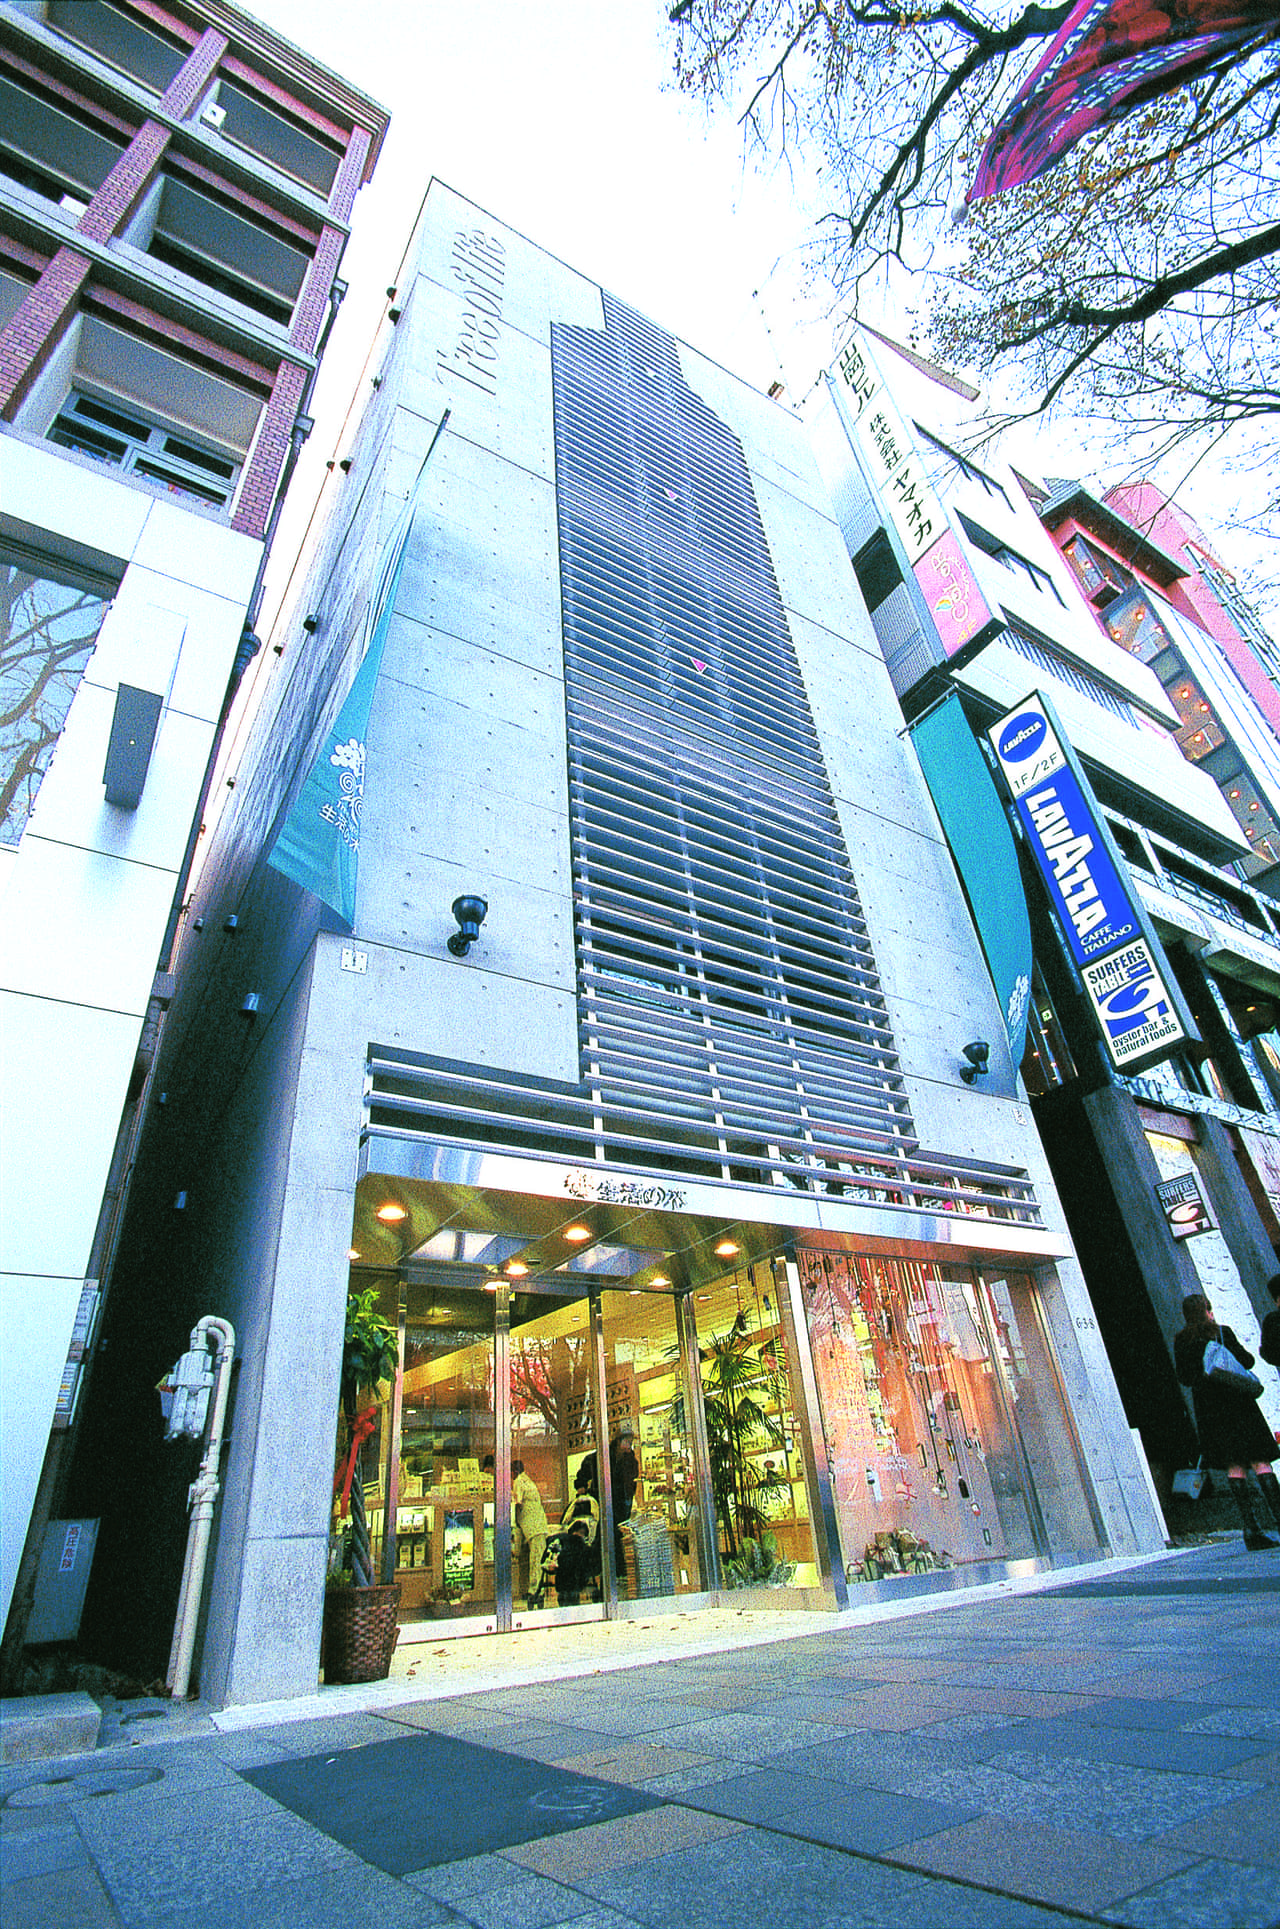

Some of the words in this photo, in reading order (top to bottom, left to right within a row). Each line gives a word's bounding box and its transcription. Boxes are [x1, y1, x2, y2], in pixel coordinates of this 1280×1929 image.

[839, 343, 875, 413] 山岡ビル
[869, 413, 903, 470] 株式会社
[892, 468, 932, 546] ヤマオカ
[1013, 752, 1058, 789] 1F/2F
[1025, 786, 1108, 938] LAVAZZA
[1083, 924, 1132, 956] ITALIANO
[1088, 946, 1146, 985] SURFERS
[1092, 969, 1131, 998] TABLE
[1112, 1027, 1141, 1049] oyster
[1141, 1020, 1159, 1038] bar
[1161, 1016, 1170, 1026] &
[1115, 1031, 1150, 1057] natural
[1150, 1021, 1178, 1042] foods
